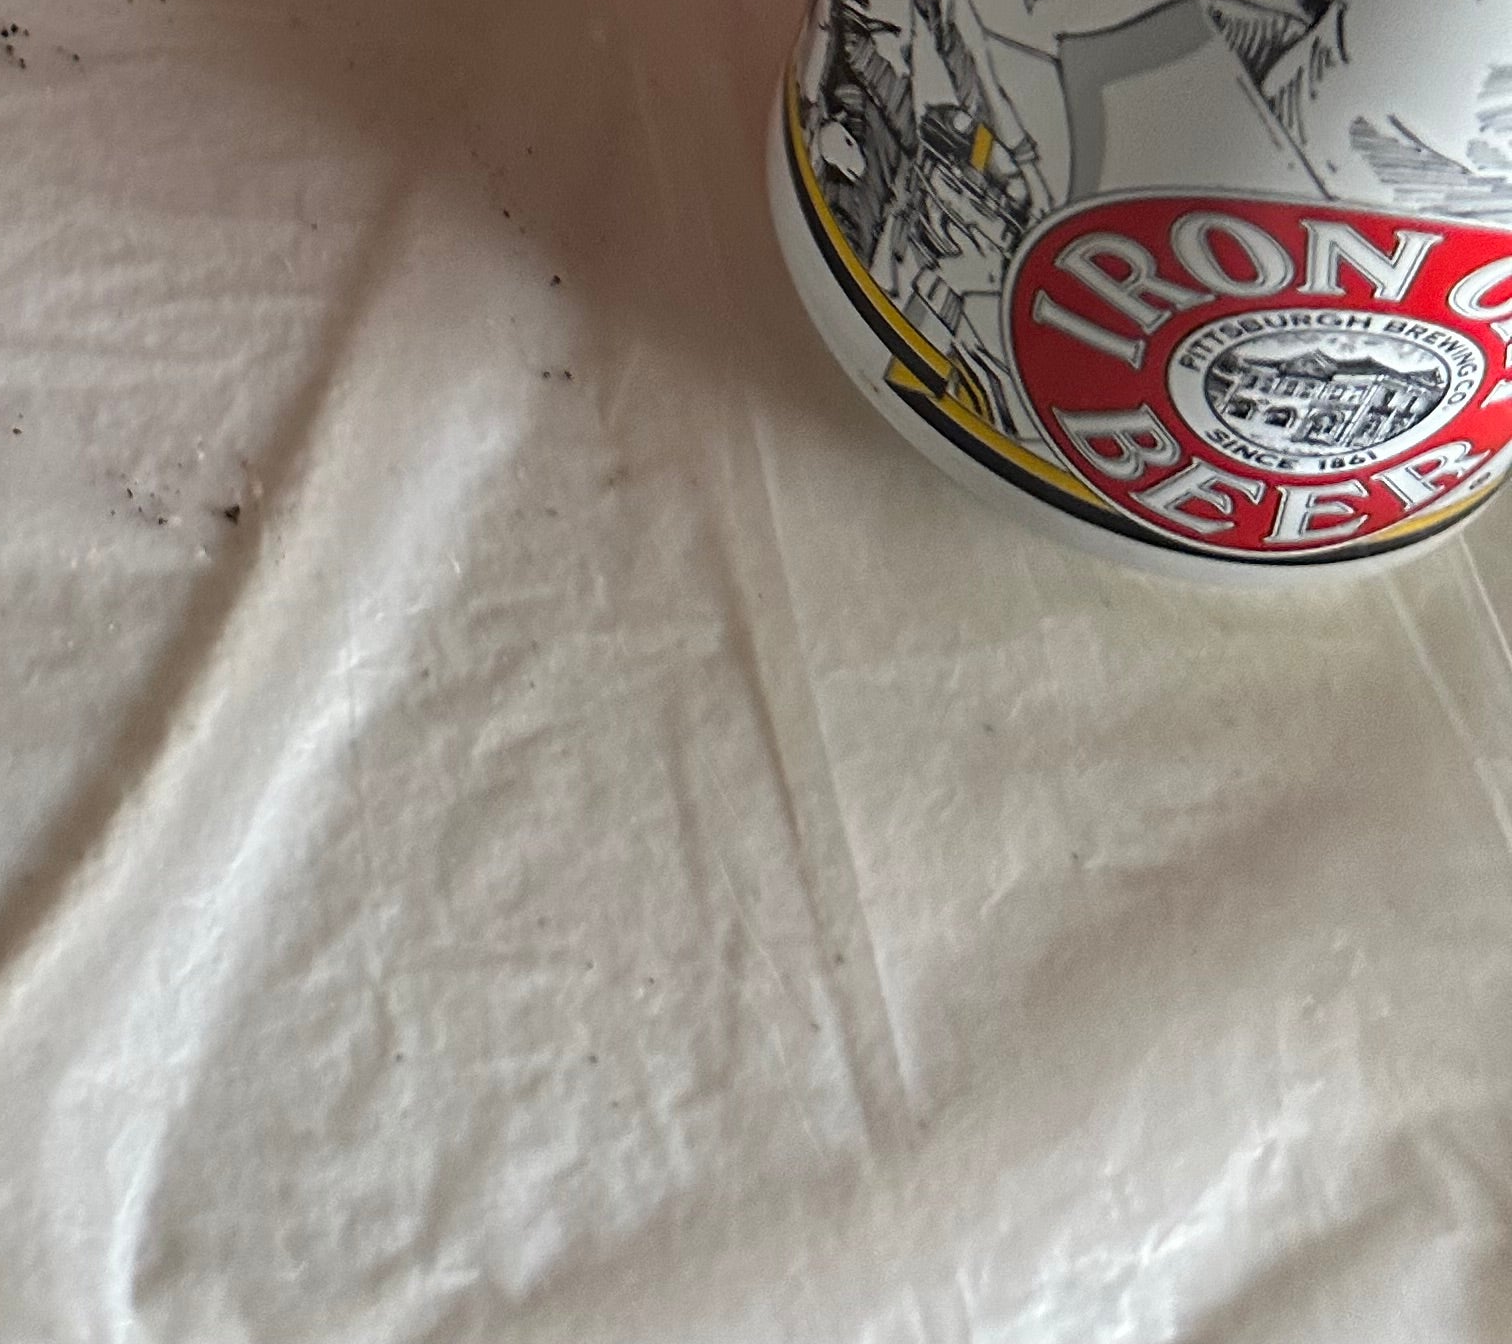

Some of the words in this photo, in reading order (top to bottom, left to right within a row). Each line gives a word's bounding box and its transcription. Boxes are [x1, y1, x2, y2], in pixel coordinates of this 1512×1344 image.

[1032, 209, 1445, 371] IRON
[1178, 311, 1372, 373] PITTSBURGH
[1383, 314, 1478, 380] BREWING
[1051, 405, 1492, 546] BEER
[1204, 427, 1299, 470] SINCE
[1318, 448, 1378, 472] 1861
